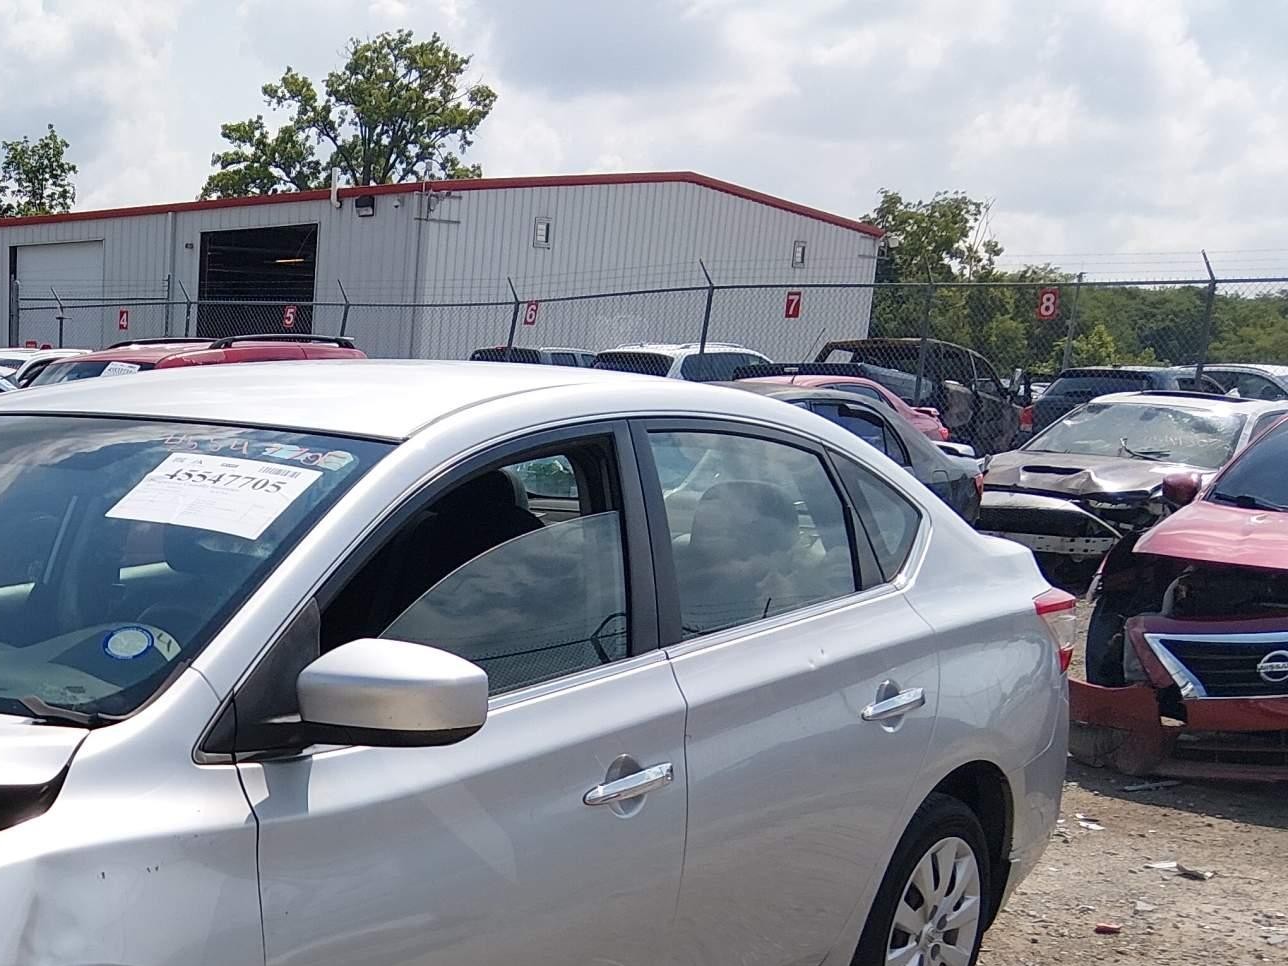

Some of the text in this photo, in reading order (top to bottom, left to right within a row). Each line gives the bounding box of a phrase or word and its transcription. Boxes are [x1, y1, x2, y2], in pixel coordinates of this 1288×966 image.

[526, 304, 537, 323] 6
[788, 294, 800, 315] 7
[1040, 293, 1055, 316] 8
[119, 312, 128, 328] 4
[285, 308, 295, 324] 5
[165, 468, 288, 494] 45547705
